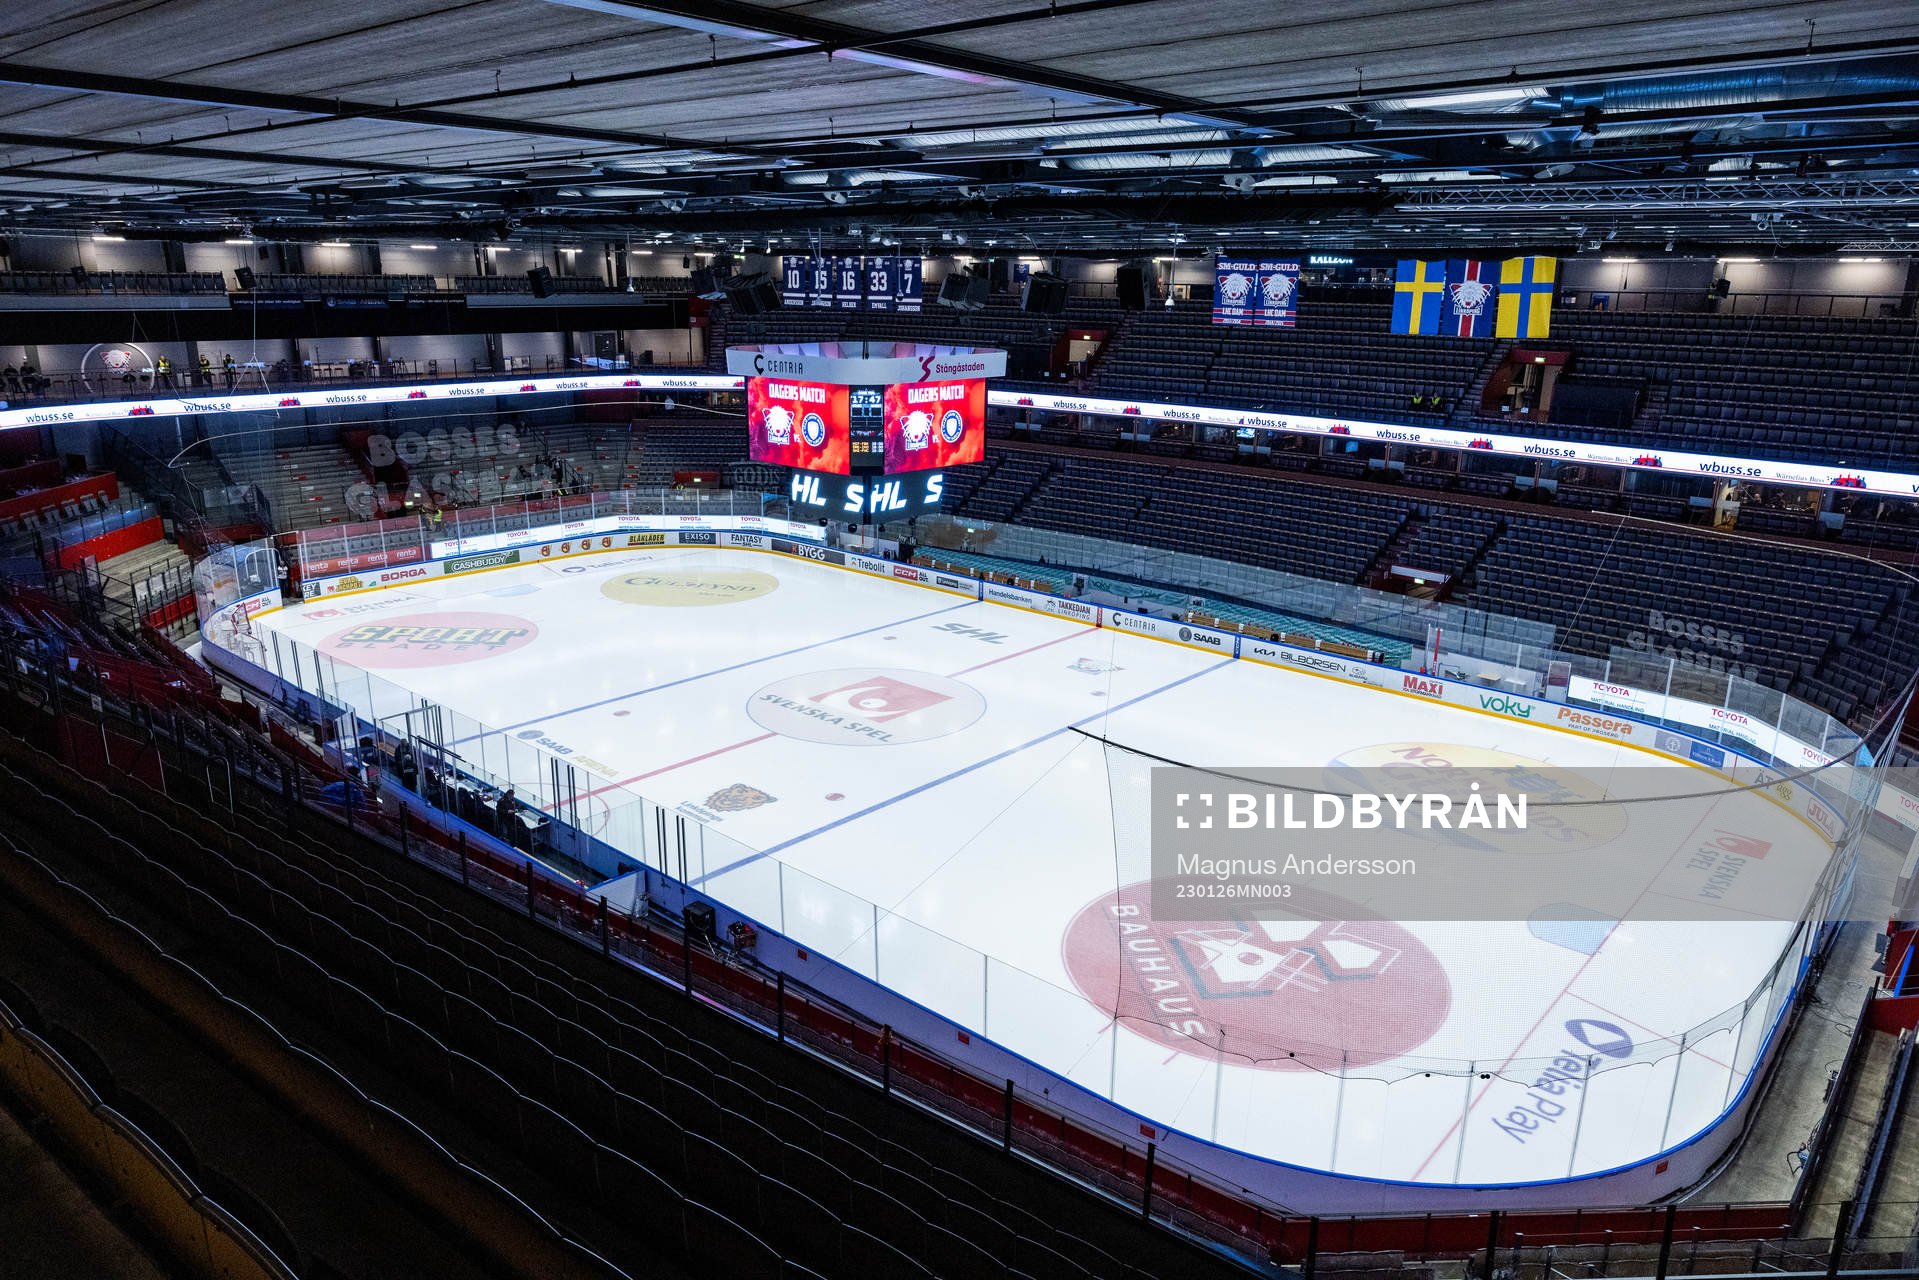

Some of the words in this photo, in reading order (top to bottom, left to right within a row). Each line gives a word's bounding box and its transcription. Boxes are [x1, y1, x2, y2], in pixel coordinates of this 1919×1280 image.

[787, 270, 800, 288] 10
[815, 270, 827, 289] 15
[842, 271, 855, 290] 16
[870, 271, 887, 291] 33
[904, 273, 912, 293] 7
[767, 360, 804, 375] CENTRIA
[936, 362, 985, 375] Stångåstaden
[556, 381, 588, 389] wbuss.se
[662, 379, 697, 387] wbuss.se
[326, 394, 367, 403] wbuss.se
[449, 387, 485, 396] wbuss.se
[769, 383, 798, 400] DAGENS
[800, 386, 825, 404] MATCH
[851, 395, 881, 403] 17:47
[908, 387, 938, 404] DAGENS
[940, 384, 964, 400] MATCH
[183, 402, 231, 412] wbuss.se
[1053, 400, 1087, 410] wbuss.se
[25, 411, 74, 423] wbuss.se
[1163, 409, 1200, 420] wbuss.se
[1247, 416, 1287, 428] wbuss.se
[1376, 429, 1421, 441] wbuss.se
[367, 424, 520, 467] BOSSES
[1524, 444, 1576, 457] wbuss.se
[1700, 461, 1761, 477] wbuss.se
[507, 530, 528, 538] TOYOTA
[731, 534, 762, 544] FANTASY
[445, 539, 467, 547] TOYOTA
[367, 553, 388, 562] renta
[396, 548, 416, 558] renta
[799, 545, 825, 560] BYGG
[453, 556, 506, 572] CASHBUDDY
[858, 559, 885, 574] Trebolit
[381, 568, 426, 582] BORGA
[895, 568, 917, 578] CCM
[989, 589, 1032, 604] Handelsbanken
[1058, 600, 1091, 615] TAKKEDJAN
[1124, 617, 1156, 631] CENTRIA
[930, 623, 1008, 645] SHL
[1194, 633, 1222, 646] SAAB
[1650, 609, 1744, 655] BOSSES
[1281, 651, 1346, 672] BILBÖRSEN
[1403, 675, 1443, 695] MAXI
[1593, 682, 1630, 697] TOYOTA
[1590, 696, 1616, 707] MATRIAL
[759, 694, 845, 725] SVENSKA
[844, 722, 894, 743] SPEL
[1557, 707, 1633, 734] Passera
[1711, 708, 1748, 725] TOYOTA
[1709, 723, 1735, 736] MATRIAL
[536, 737, 574, 755] SAAB
[1809, 803, 1836, 836] JULA
[1685, 848, 1719, 872] SPEL
[1698, 855, 1747, 900] SVENSKA
[1110, 904, 1206, 1036] BAUHAUS
[1535, 1048, 1603, 1096] Telia
[1491, 1092, 1567, 1144] Play
